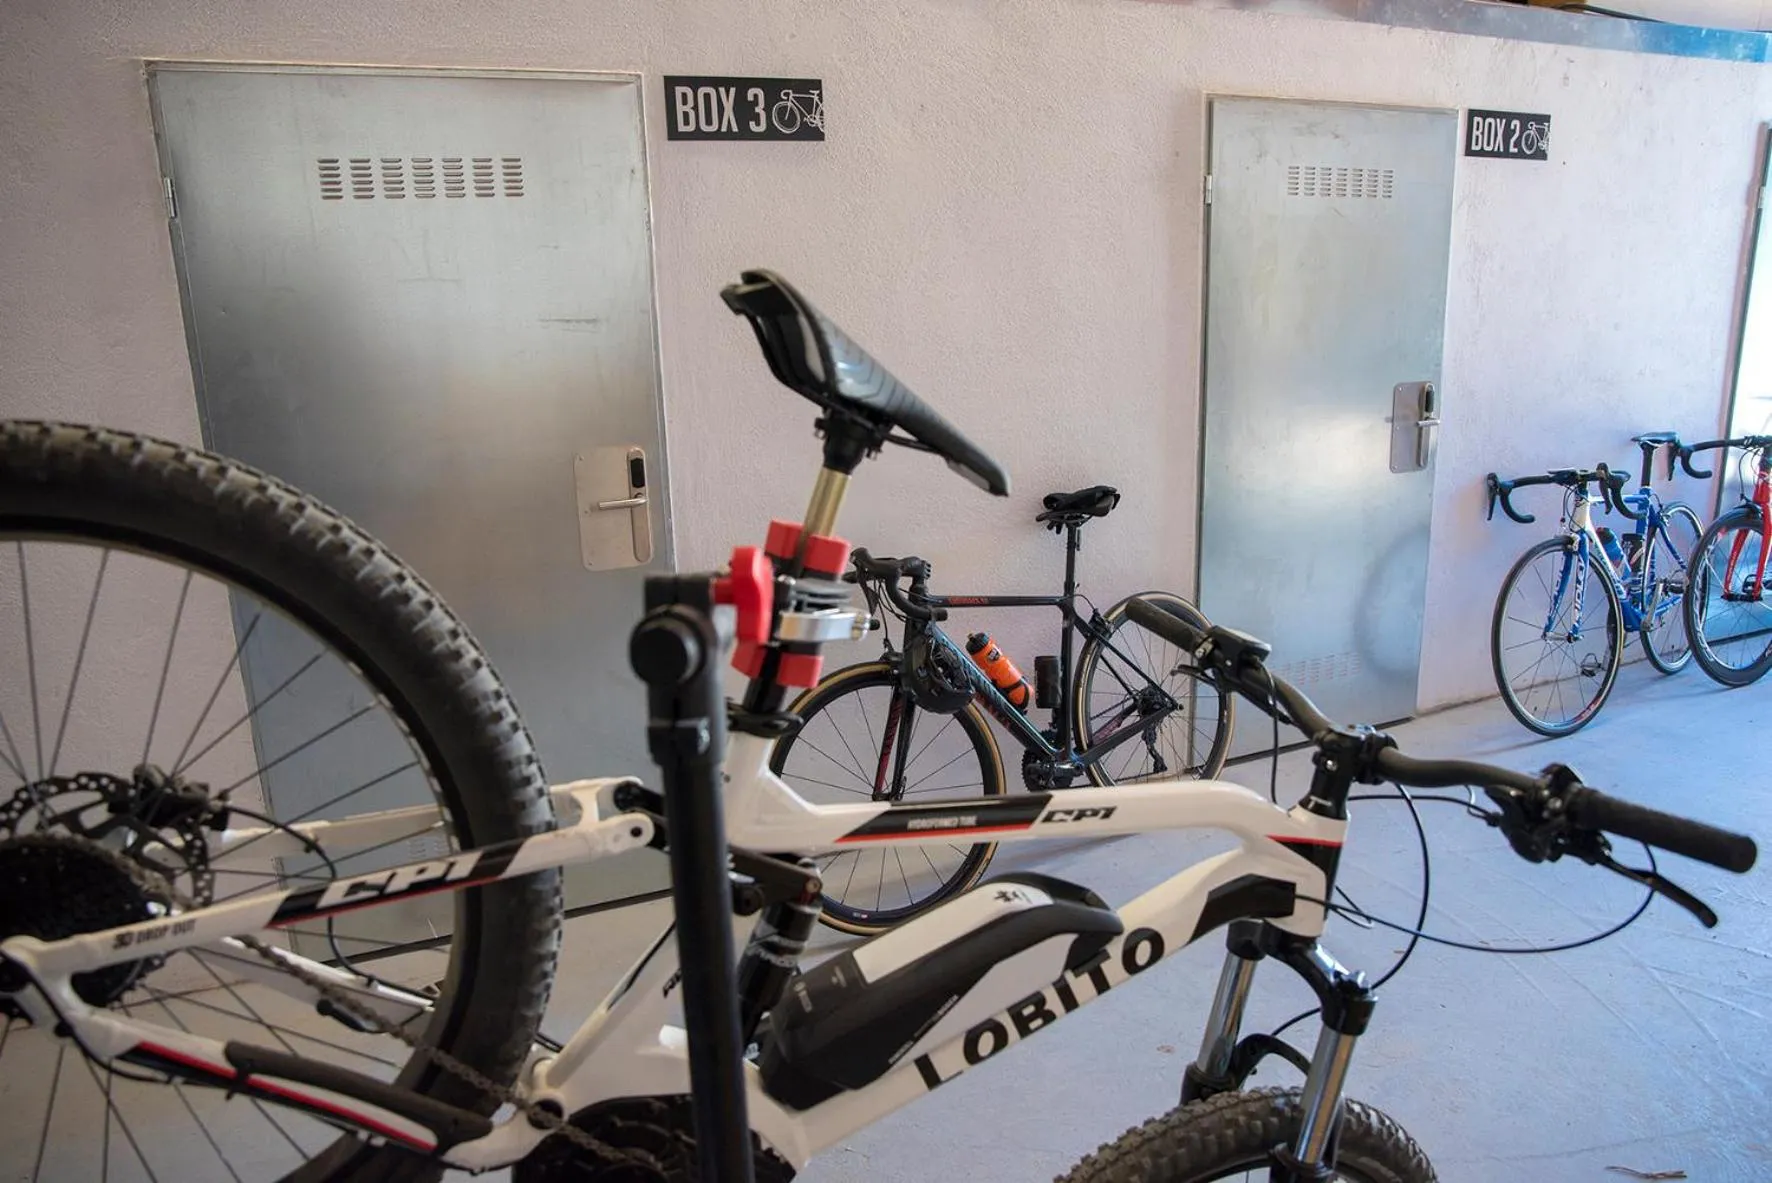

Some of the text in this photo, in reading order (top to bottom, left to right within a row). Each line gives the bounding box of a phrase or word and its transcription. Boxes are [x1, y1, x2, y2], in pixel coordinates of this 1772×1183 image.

[675, 86, 768, 133] BOX 3
[1471, 116, 1520, 153] BOX 2
[914, 927, 1165, 1091] LOBITO
